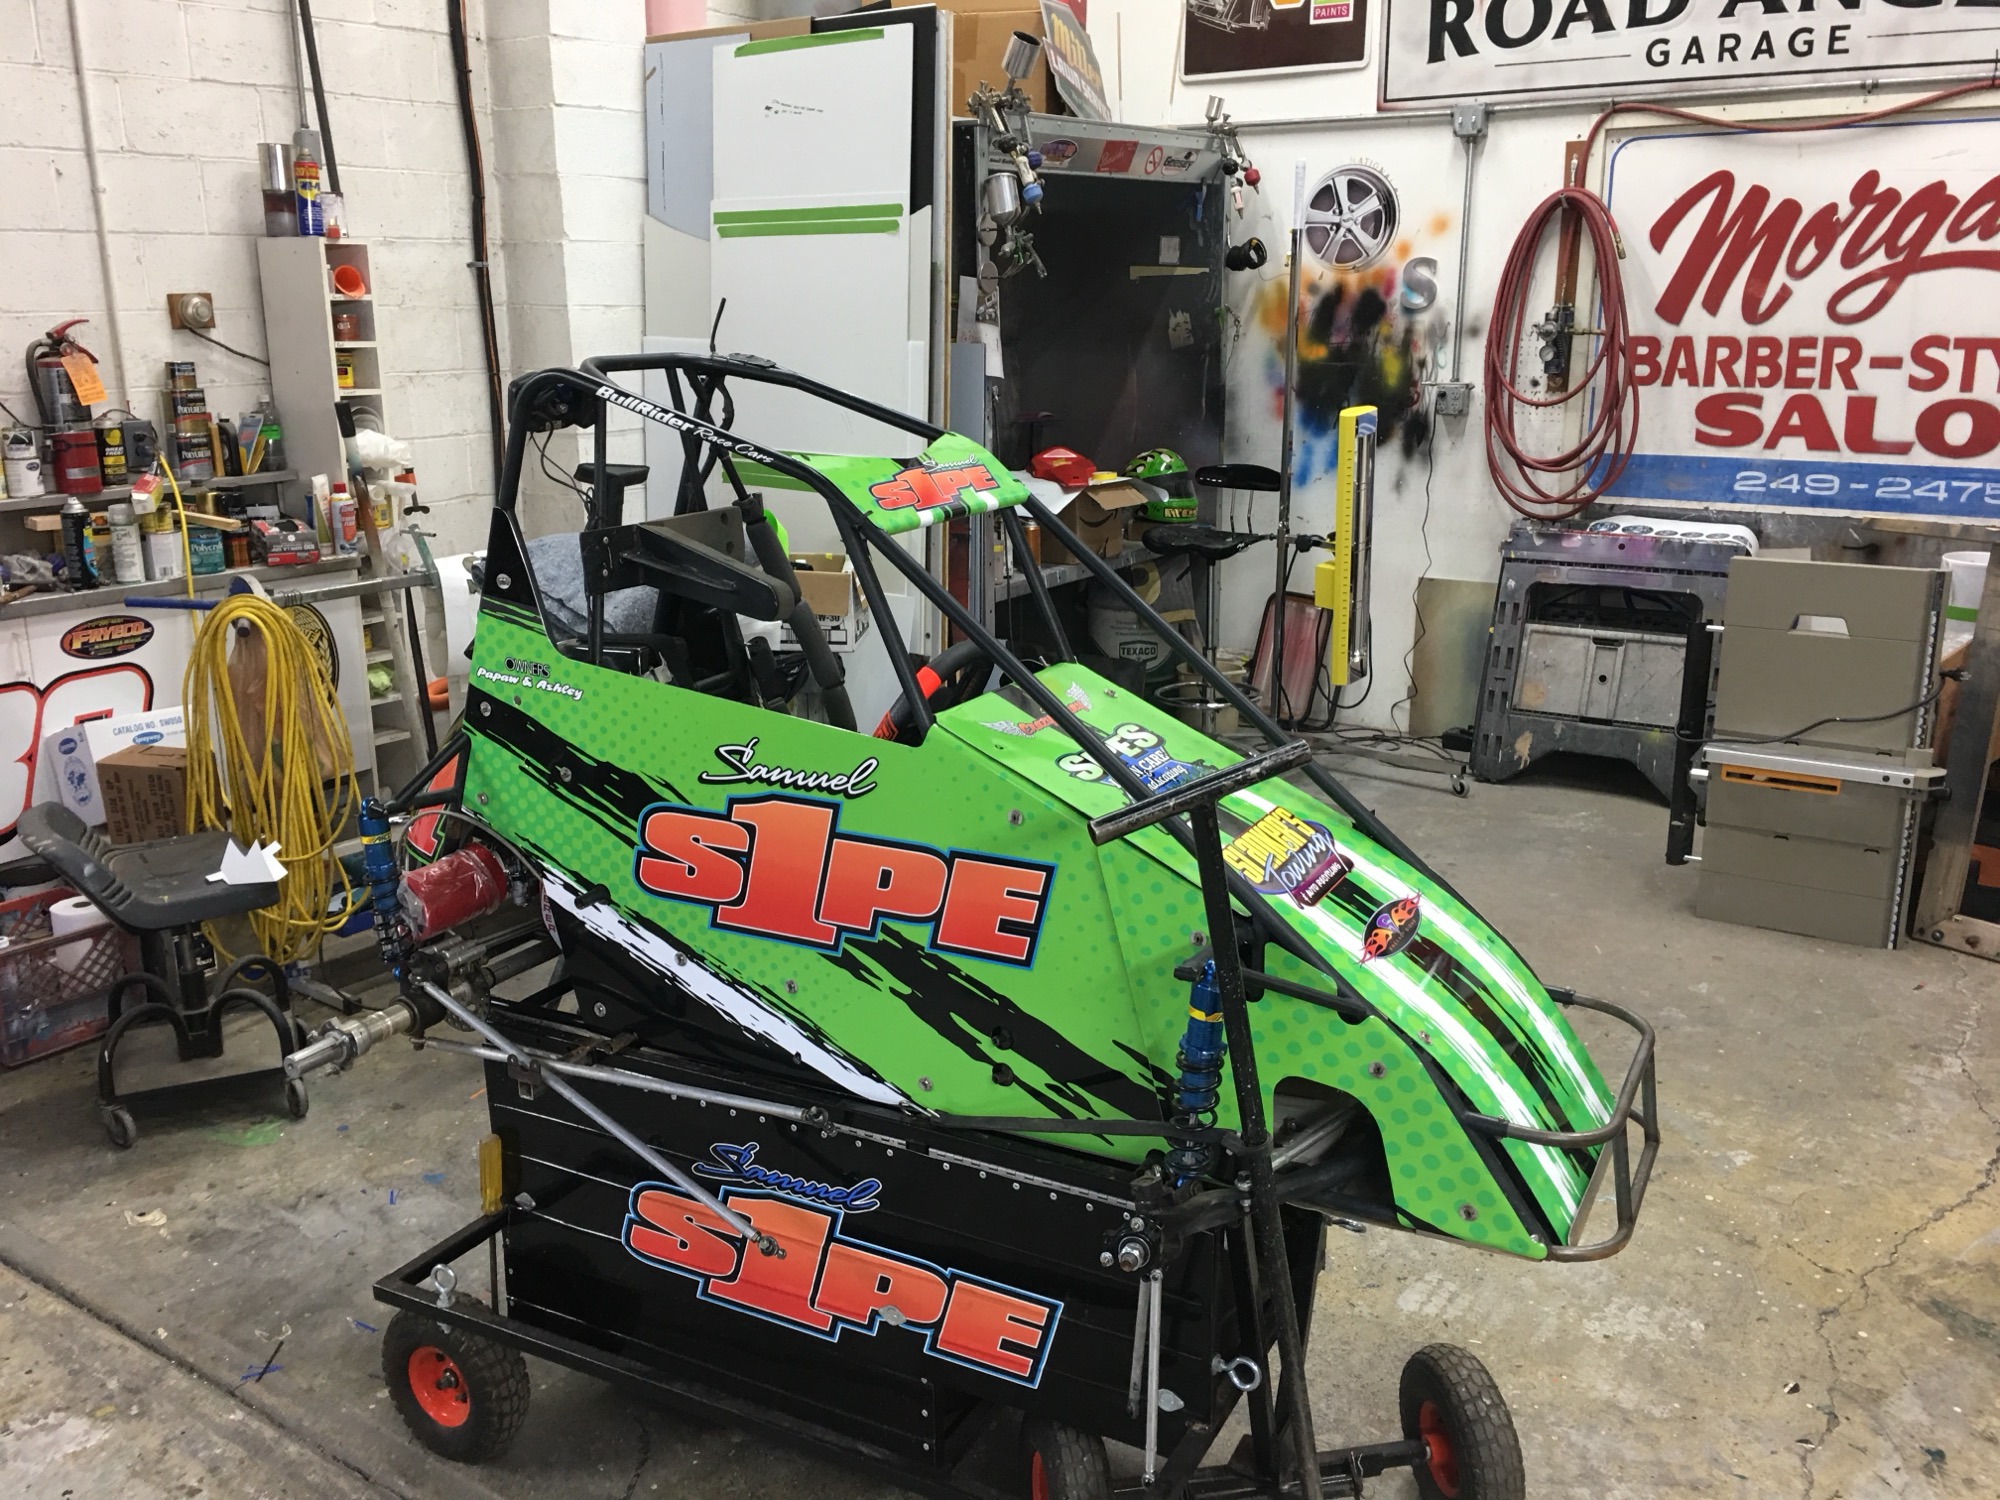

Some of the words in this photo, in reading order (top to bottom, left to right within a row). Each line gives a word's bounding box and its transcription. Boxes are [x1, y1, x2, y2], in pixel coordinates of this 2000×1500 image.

[1314, 8, 1350, 18] PAINTS
[1645, 25, 1852, 67] GARAGE
[595, 385, 676, 432] BullRider
[693, 426, 734, 448] Race
[735, 442, 776, 464] Cars
[922, 453, 978, 473] Samuel
[1120, 646, 1157, 657] TEXACO
[504, 657, 551, 679] OWNERS
[476, 667, 520, 685] Papaw
[522, 676, 534, 688] &
[536, 679, 584, 701] Ashley
[112, 723, 144, 736] CATALOG
[701, 737, 879, 798] Samuel
[1138, 747, 1170, 772] CARE
[1264, 832, 1350, 910] Towing
[692, 1143, 882, 1212] Samuel
